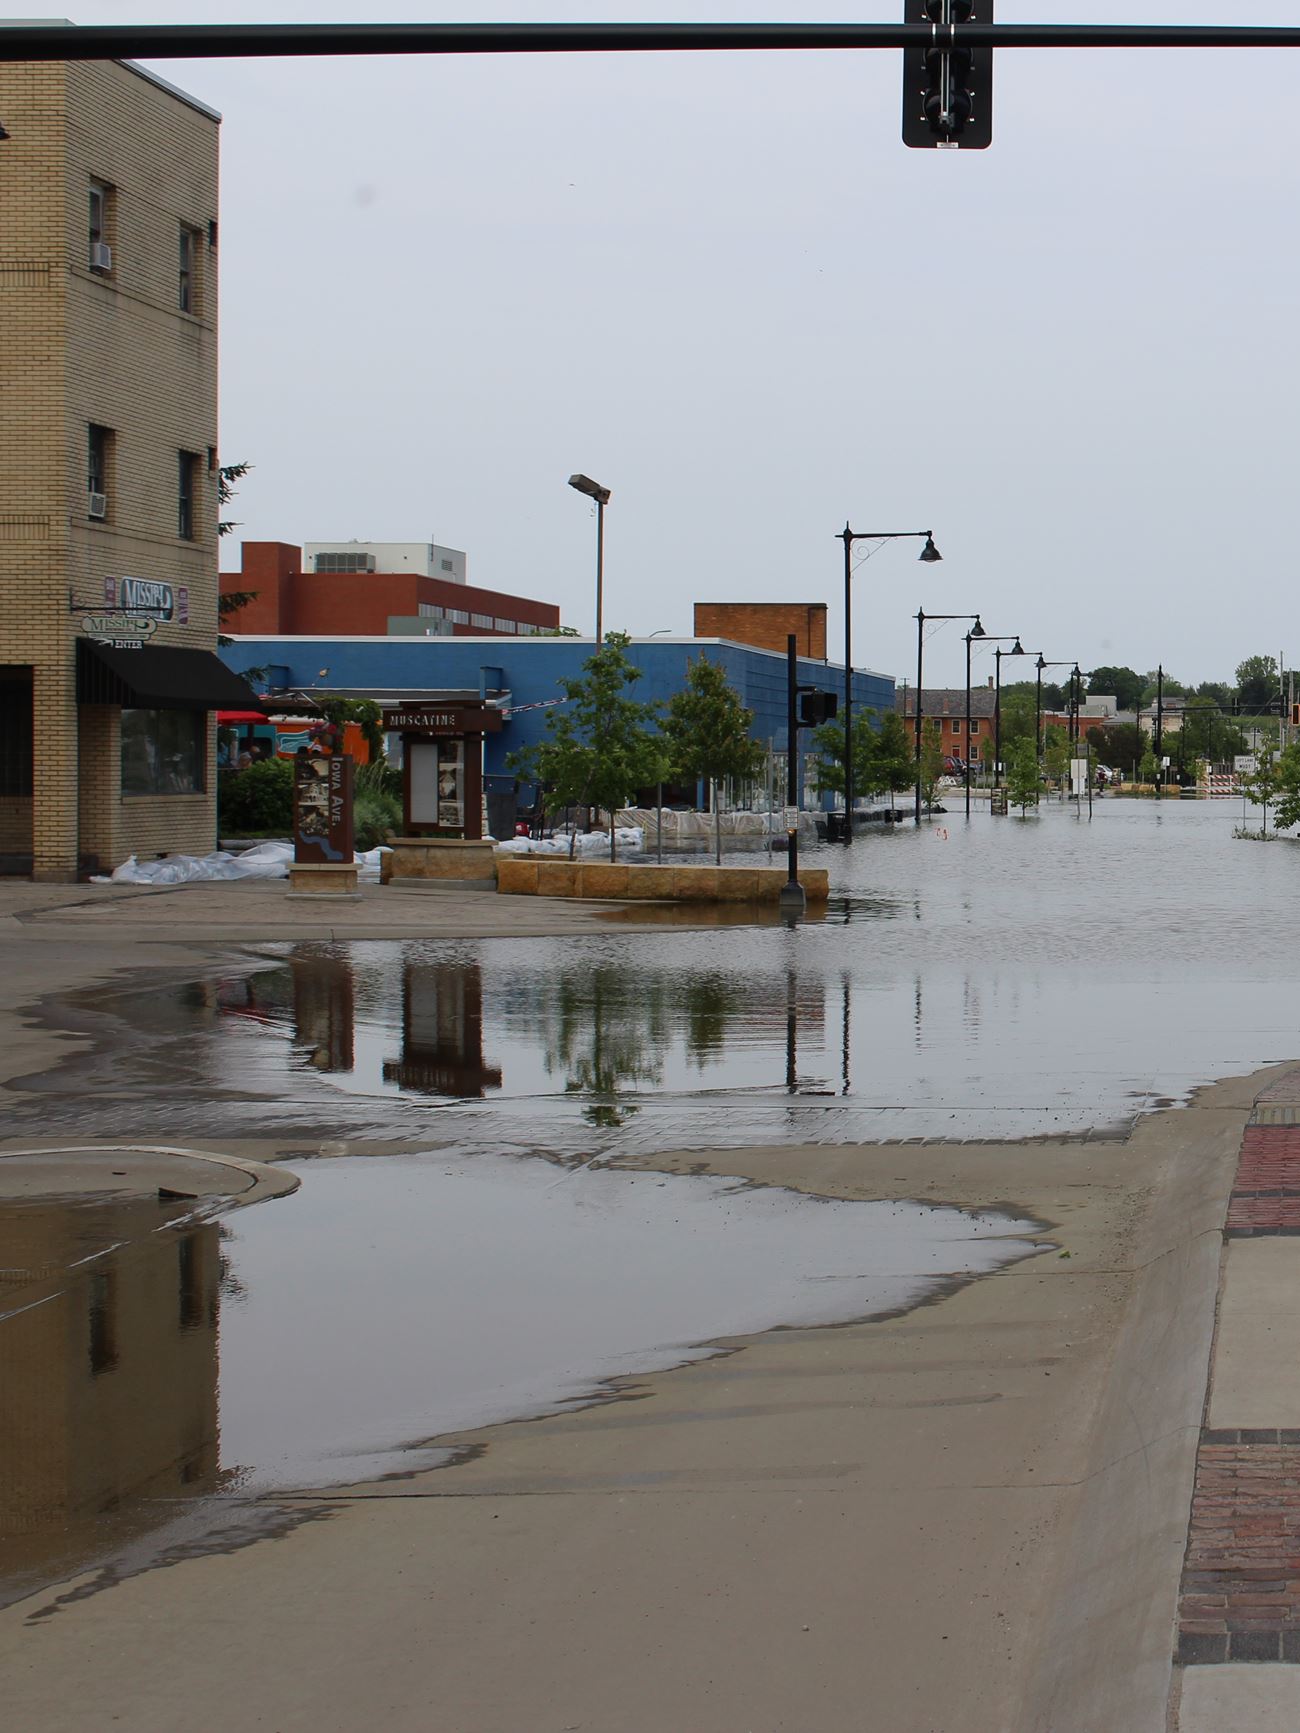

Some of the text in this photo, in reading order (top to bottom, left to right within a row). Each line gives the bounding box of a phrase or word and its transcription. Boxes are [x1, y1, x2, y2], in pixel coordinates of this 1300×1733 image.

[115, 640, 142, 648] ENTER
[389, 715, 456, 727] MUSCATINE
[331, 757, 344, 827] IOWA AVE.
